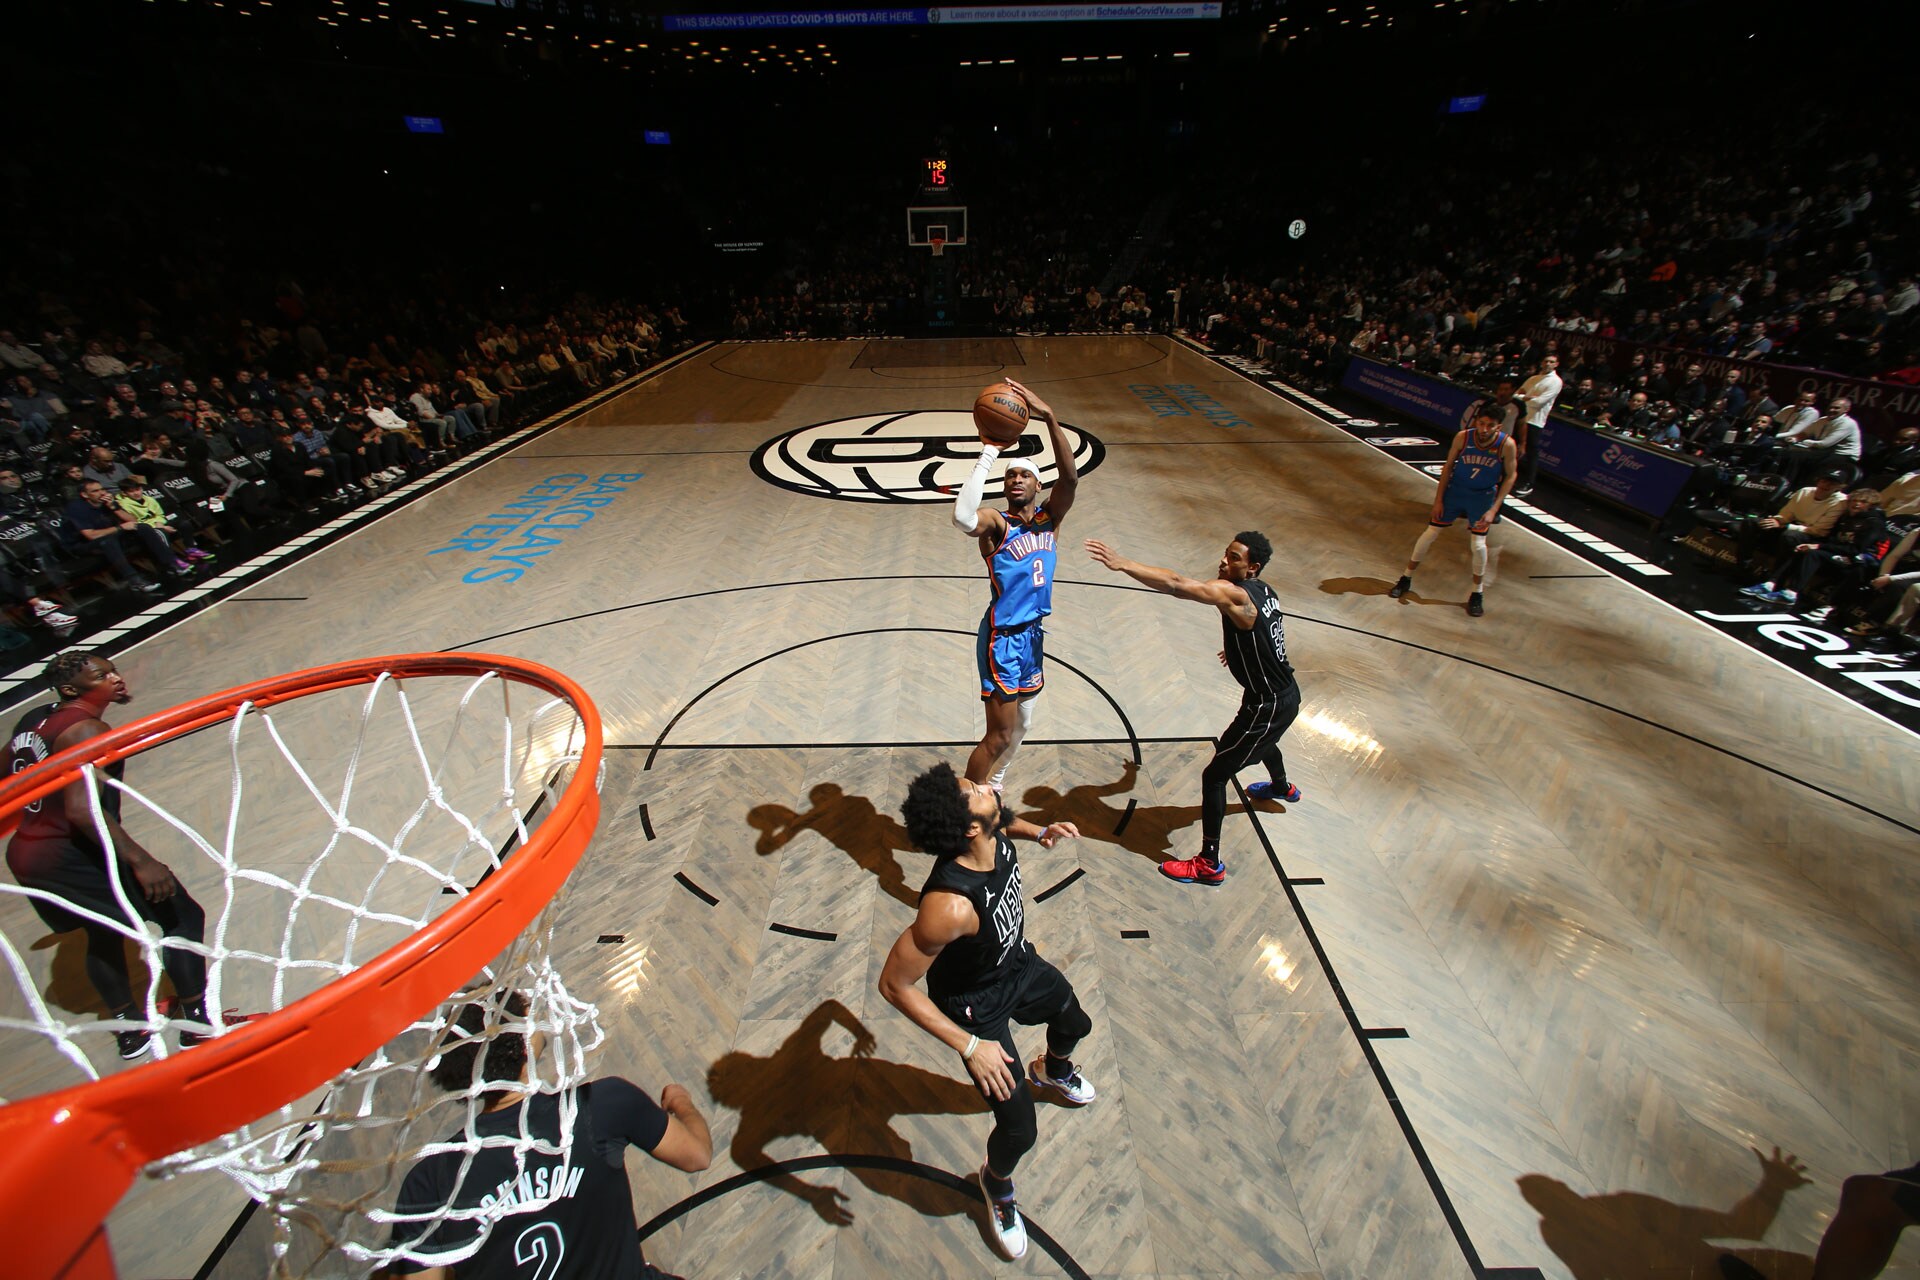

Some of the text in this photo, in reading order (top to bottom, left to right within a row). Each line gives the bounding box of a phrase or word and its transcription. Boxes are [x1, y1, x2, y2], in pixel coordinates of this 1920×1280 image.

[676, 17, 697, 28] THIS
[701, 16, 745, 27] SEASON'S
[746, 15, 789, 25] UPDATED
[790, 13, 834, 24] COVID-19
[835, 12, 868, 23] SHOTS
[869, 12, 888, 22] ARE
[950, 10, 973, 19] Learn
[997, 9, 1020, 18] about
[1028, 9, 1059, 17] vaccine
[1061, 8, 1085, 19] option
[1086, 7, 1096, 16] at
[1096, 5, 1195, 17] ScheduleCovidVax.com
[931, 169, 946, 185] 15
[1128, 383, 1192, 418] CENTER
[1798, 377, 1882, 407] QATAR
[993, 396, 1027, 419] Wilson
[1164, 383, 1254, 429] BARCLAYS
[225, 455, 249, 468] QATAR
[1461, 454, 1499, 468] THUNDER
[1615, 453, 1647, 471] pfizer
[163, 476, 193, 489] QATAR
[1469, 467, 1482, 480] 7
[424, 473, 589, 556] CENTER
[461, 472, 646, 584] BARCLAYS
[1005, 532, 1057, 561] THUNDER
[1031, 558, 1046, 587] 2
